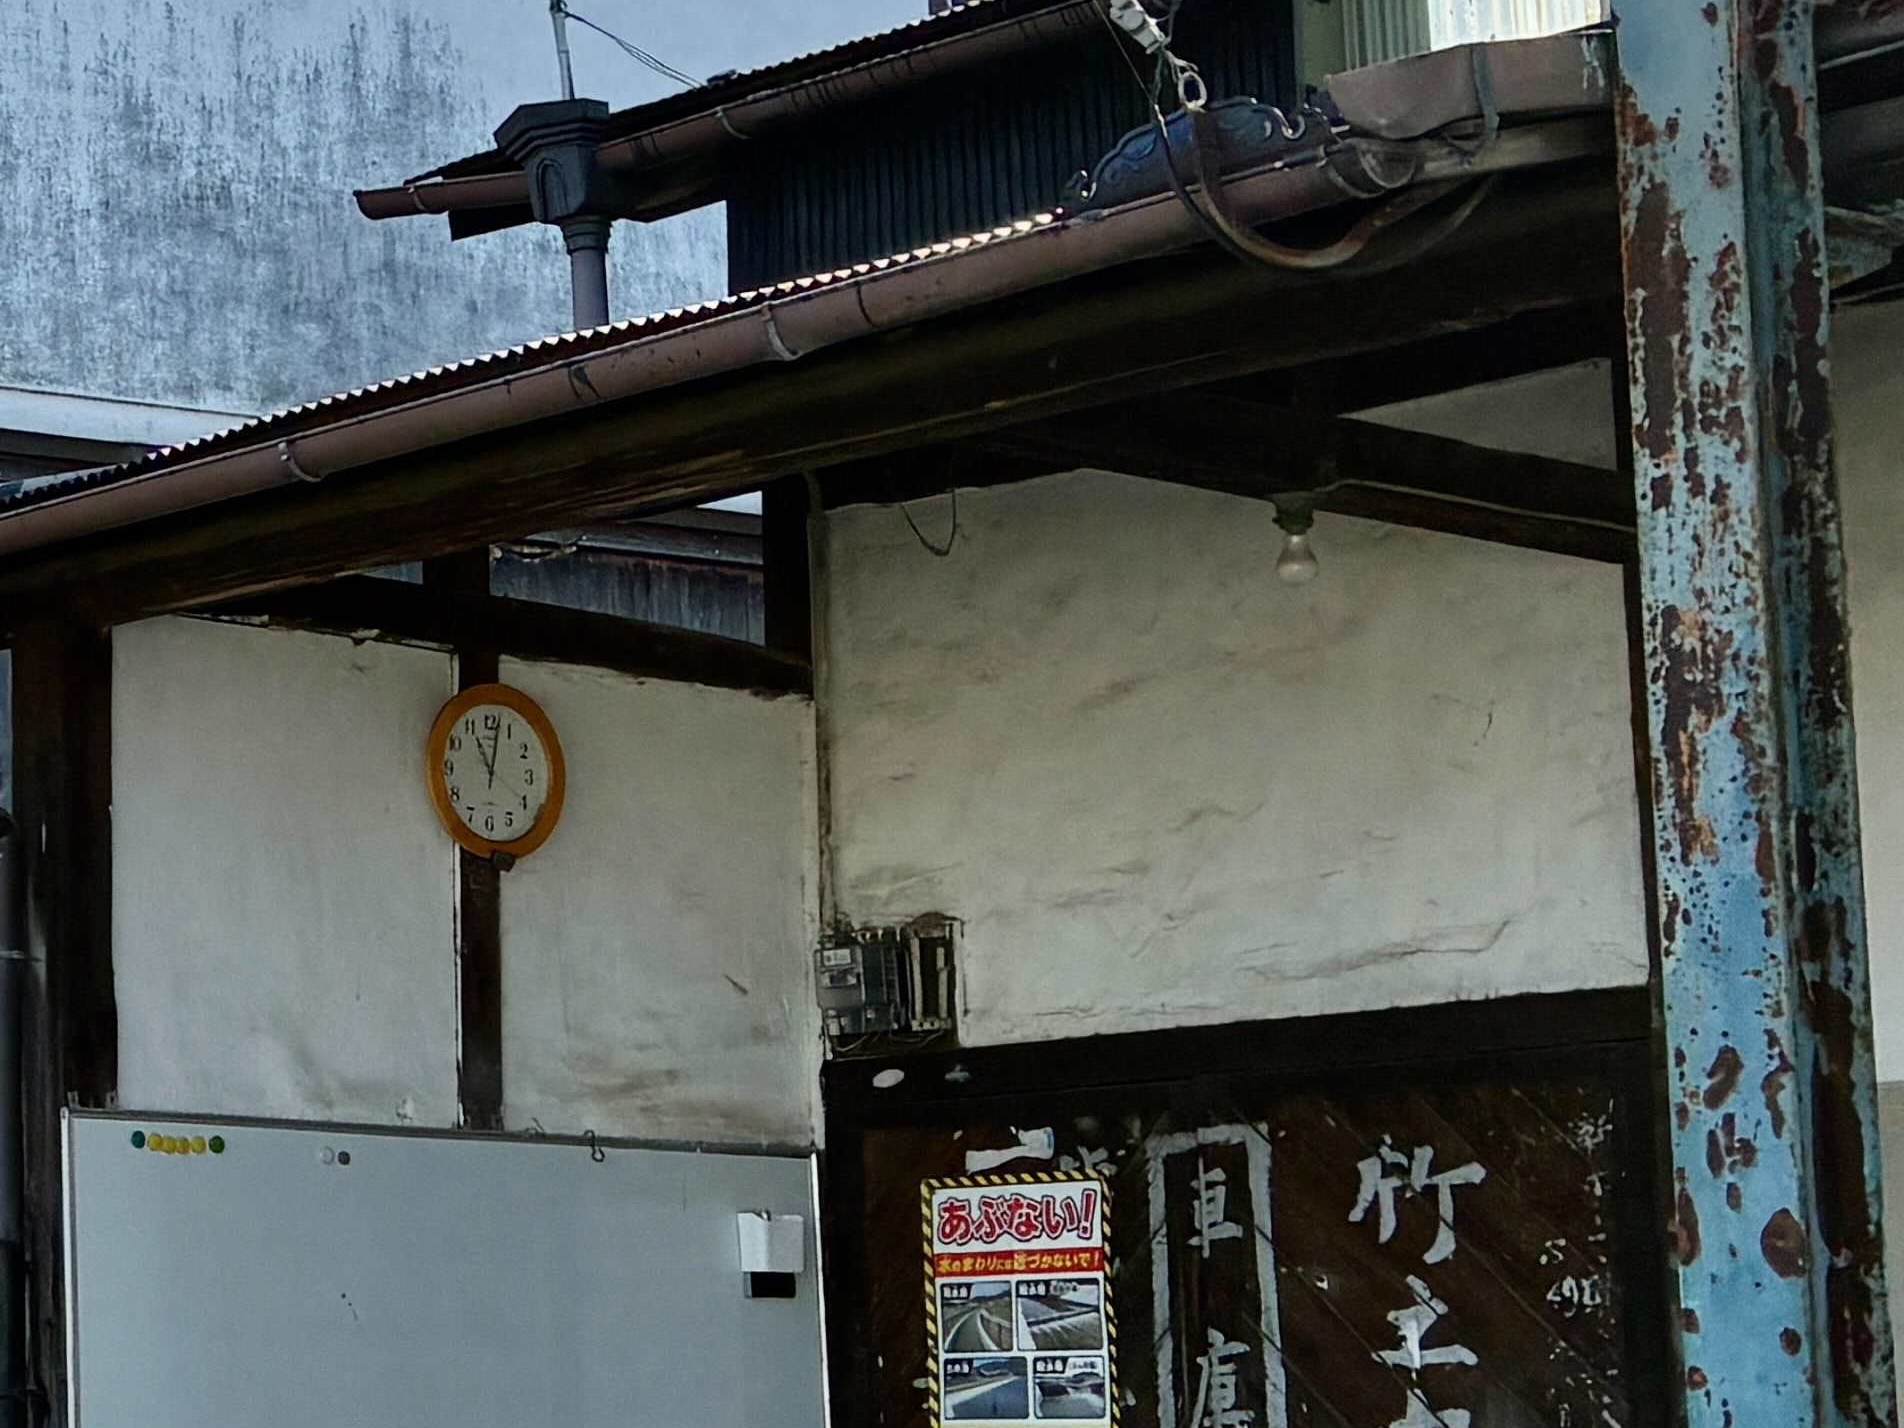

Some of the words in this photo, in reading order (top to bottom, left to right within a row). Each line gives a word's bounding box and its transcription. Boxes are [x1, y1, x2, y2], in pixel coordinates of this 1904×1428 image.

[519, 742, 529, 760] 2
[524, 768, 534, 786] 3
[504, 811, 514, 828] 5
[938, 1187, 1097, 1246] あぶない！
